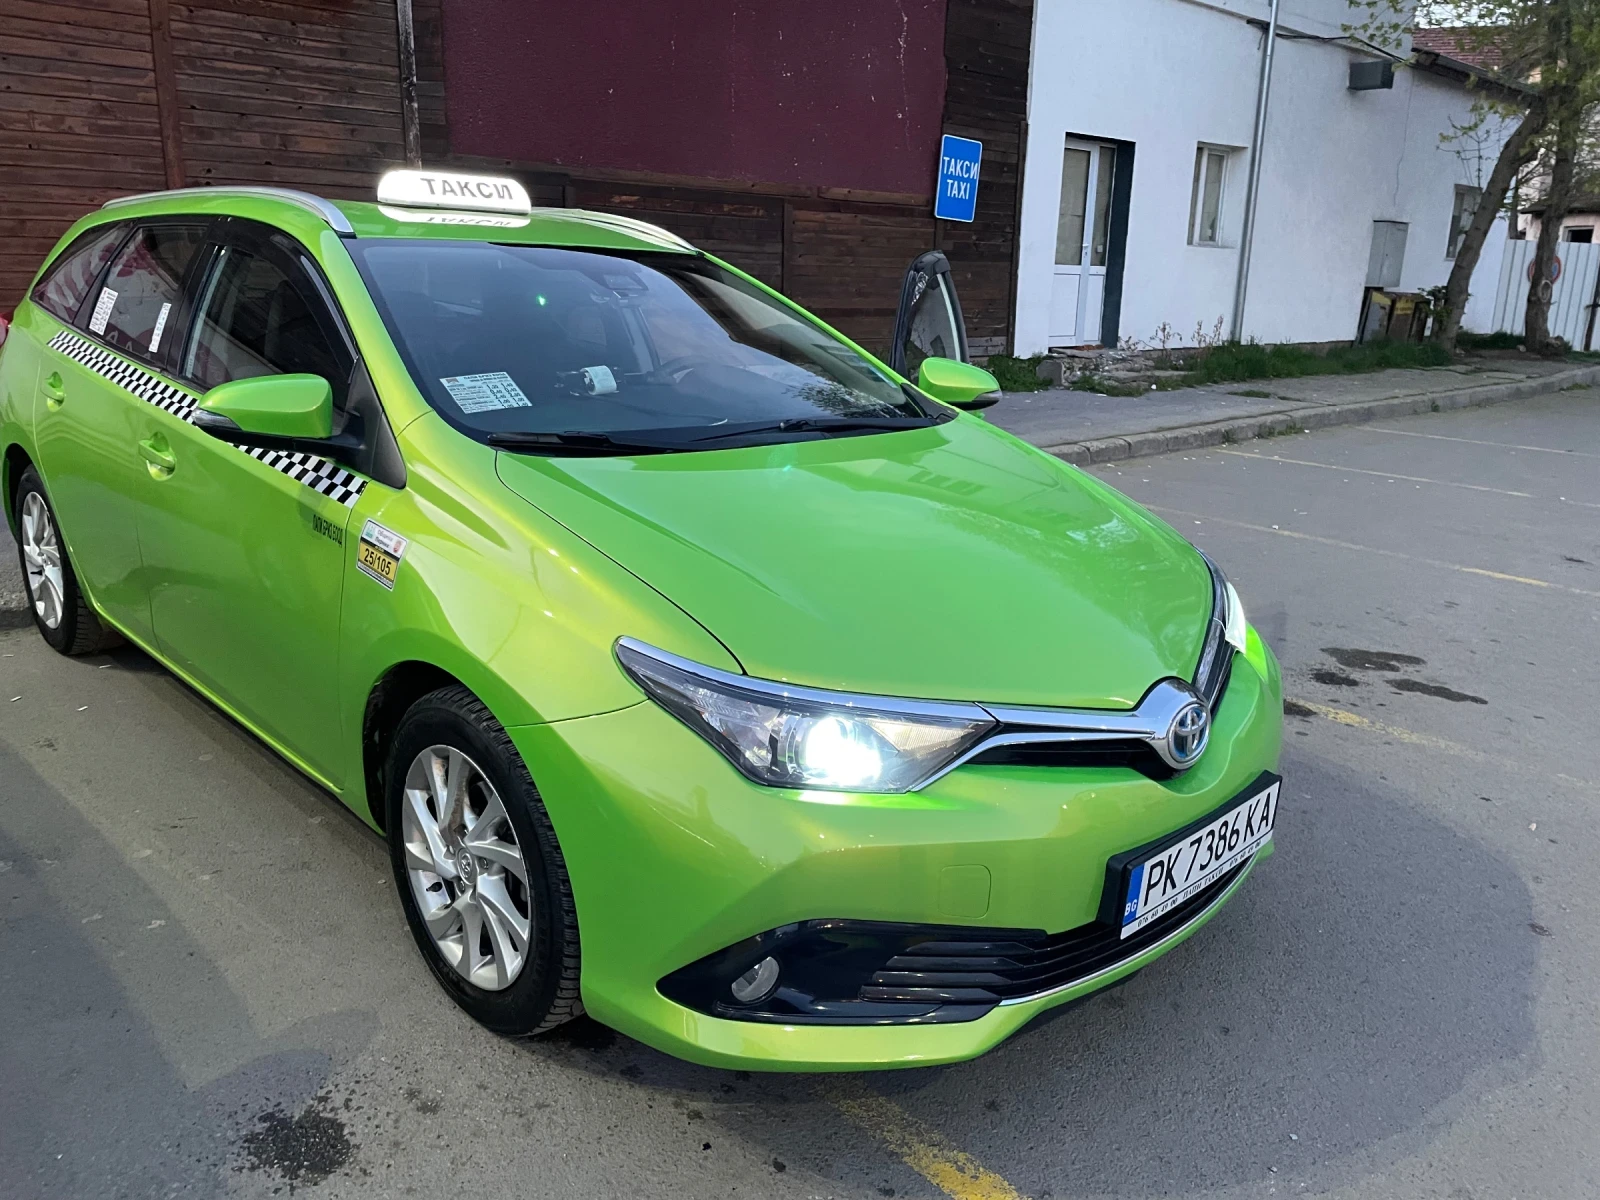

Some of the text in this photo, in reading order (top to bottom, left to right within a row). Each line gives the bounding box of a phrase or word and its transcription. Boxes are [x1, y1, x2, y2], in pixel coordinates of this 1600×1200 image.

[943, 156, 978, 180] ТАКСИ
[420, 177, 514, 200] ТАКСИ
[946, 179, 970, 200] TAXI
[364, 548, 392, 576] 25/105
[1143, 791, 1271, 908] PK 7386 KA
[1124, 899, 1138, 917] BG
